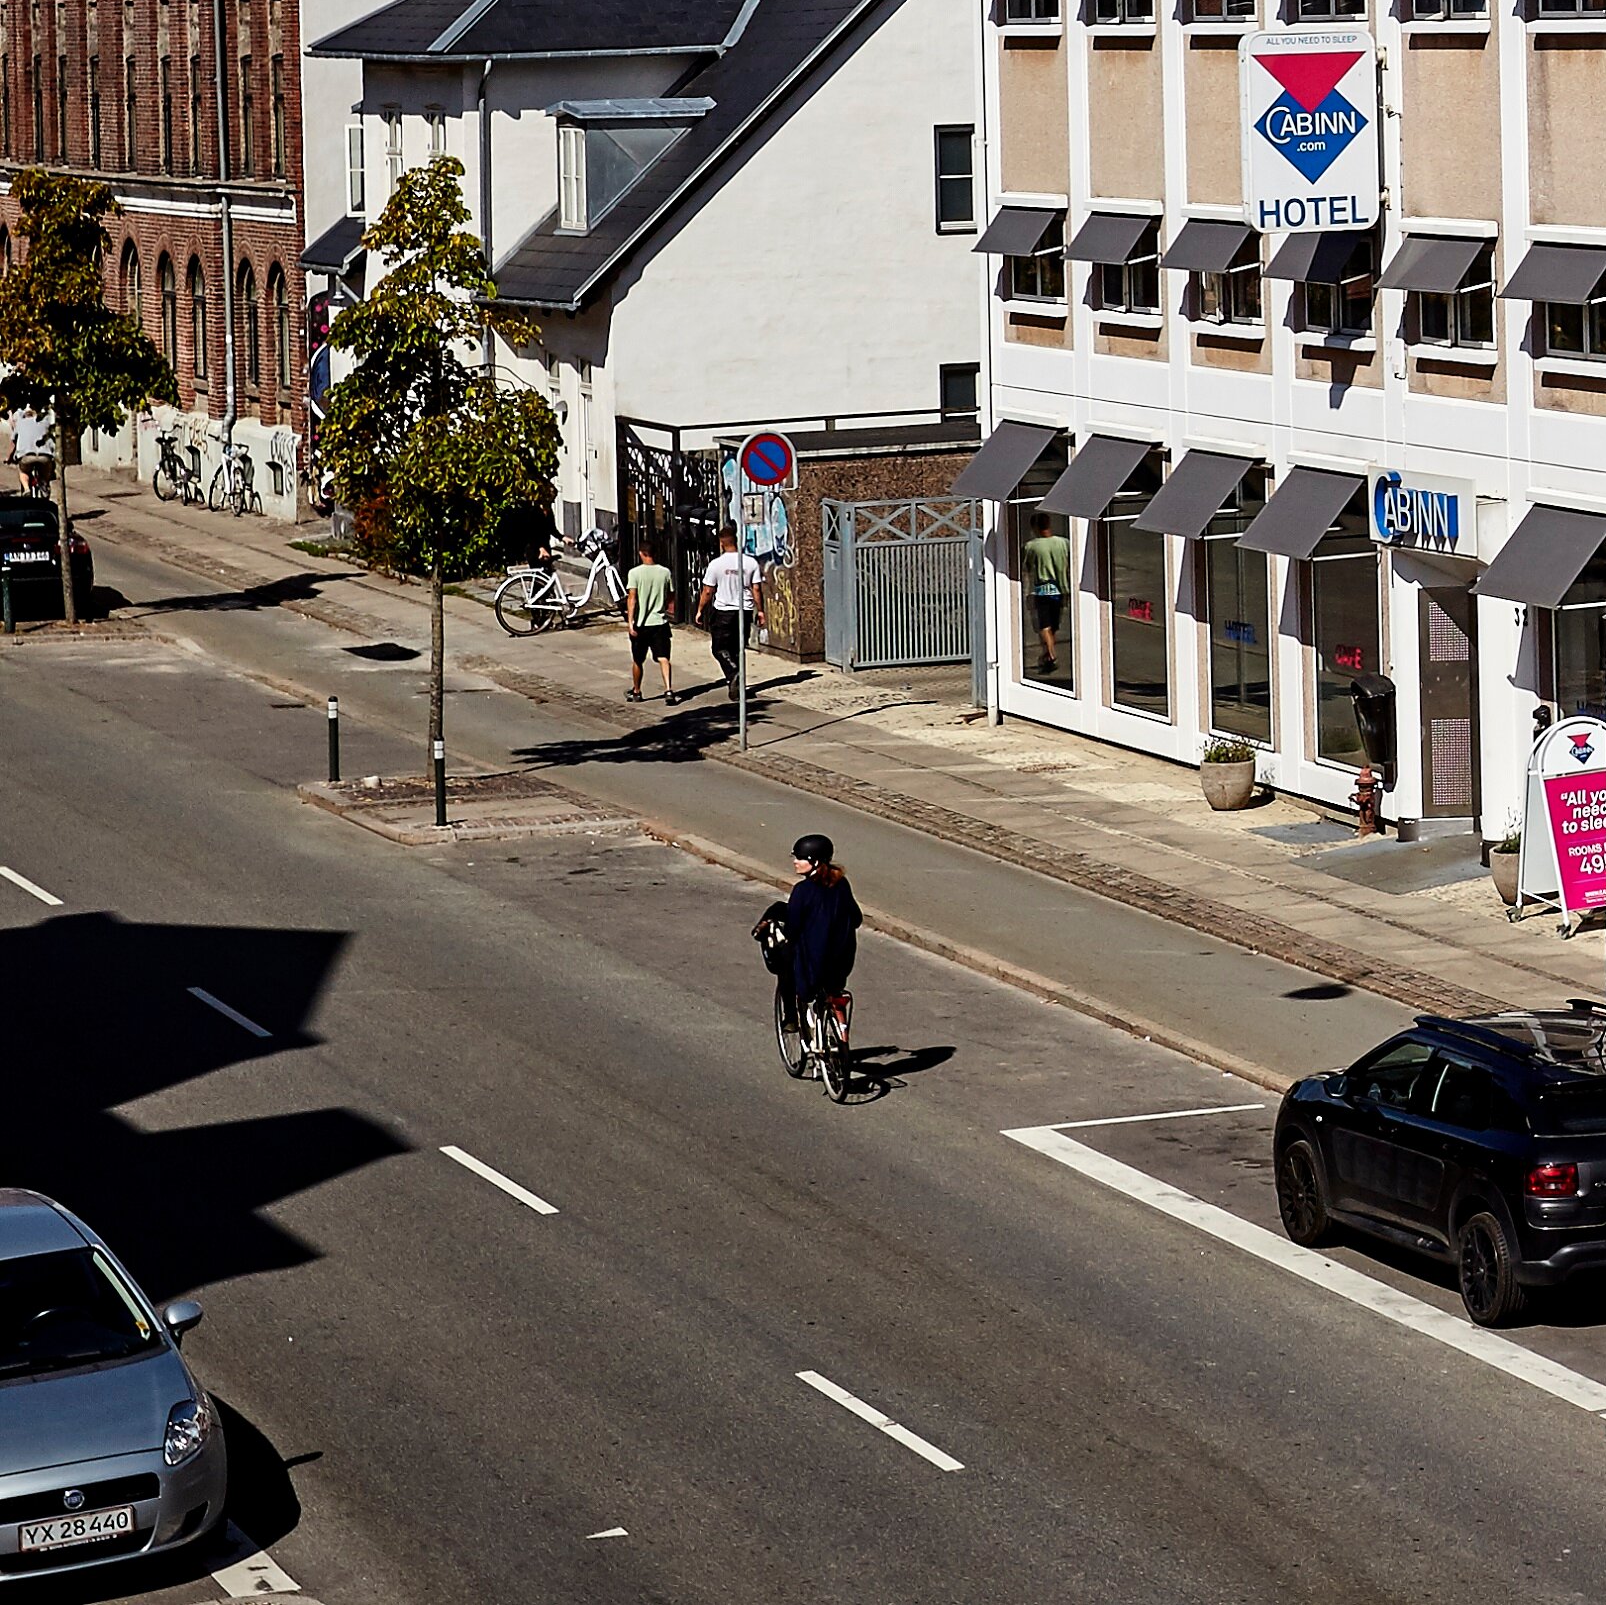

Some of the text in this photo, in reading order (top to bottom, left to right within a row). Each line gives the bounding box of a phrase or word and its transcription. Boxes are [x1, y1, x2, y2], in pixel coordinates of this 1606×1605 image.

[1266, 35, 1358, 45] ALL YOU NEED TO SLEEP
[1265, 106, 1356, 144] CABINN
[1296, 141, 1326, 151] .com
[1259, 196, 1369, 228] HOTEL
[1374, 469, 1460, 543] CABINN
[1562, 820, 1578, 834] to
[1568, 843, 1602, 857] ROOMS
[26, 1524, 54, 1544] YX
[60, 1519, 86, 1539] 28
[89, 1511, 129, 1533] 440
